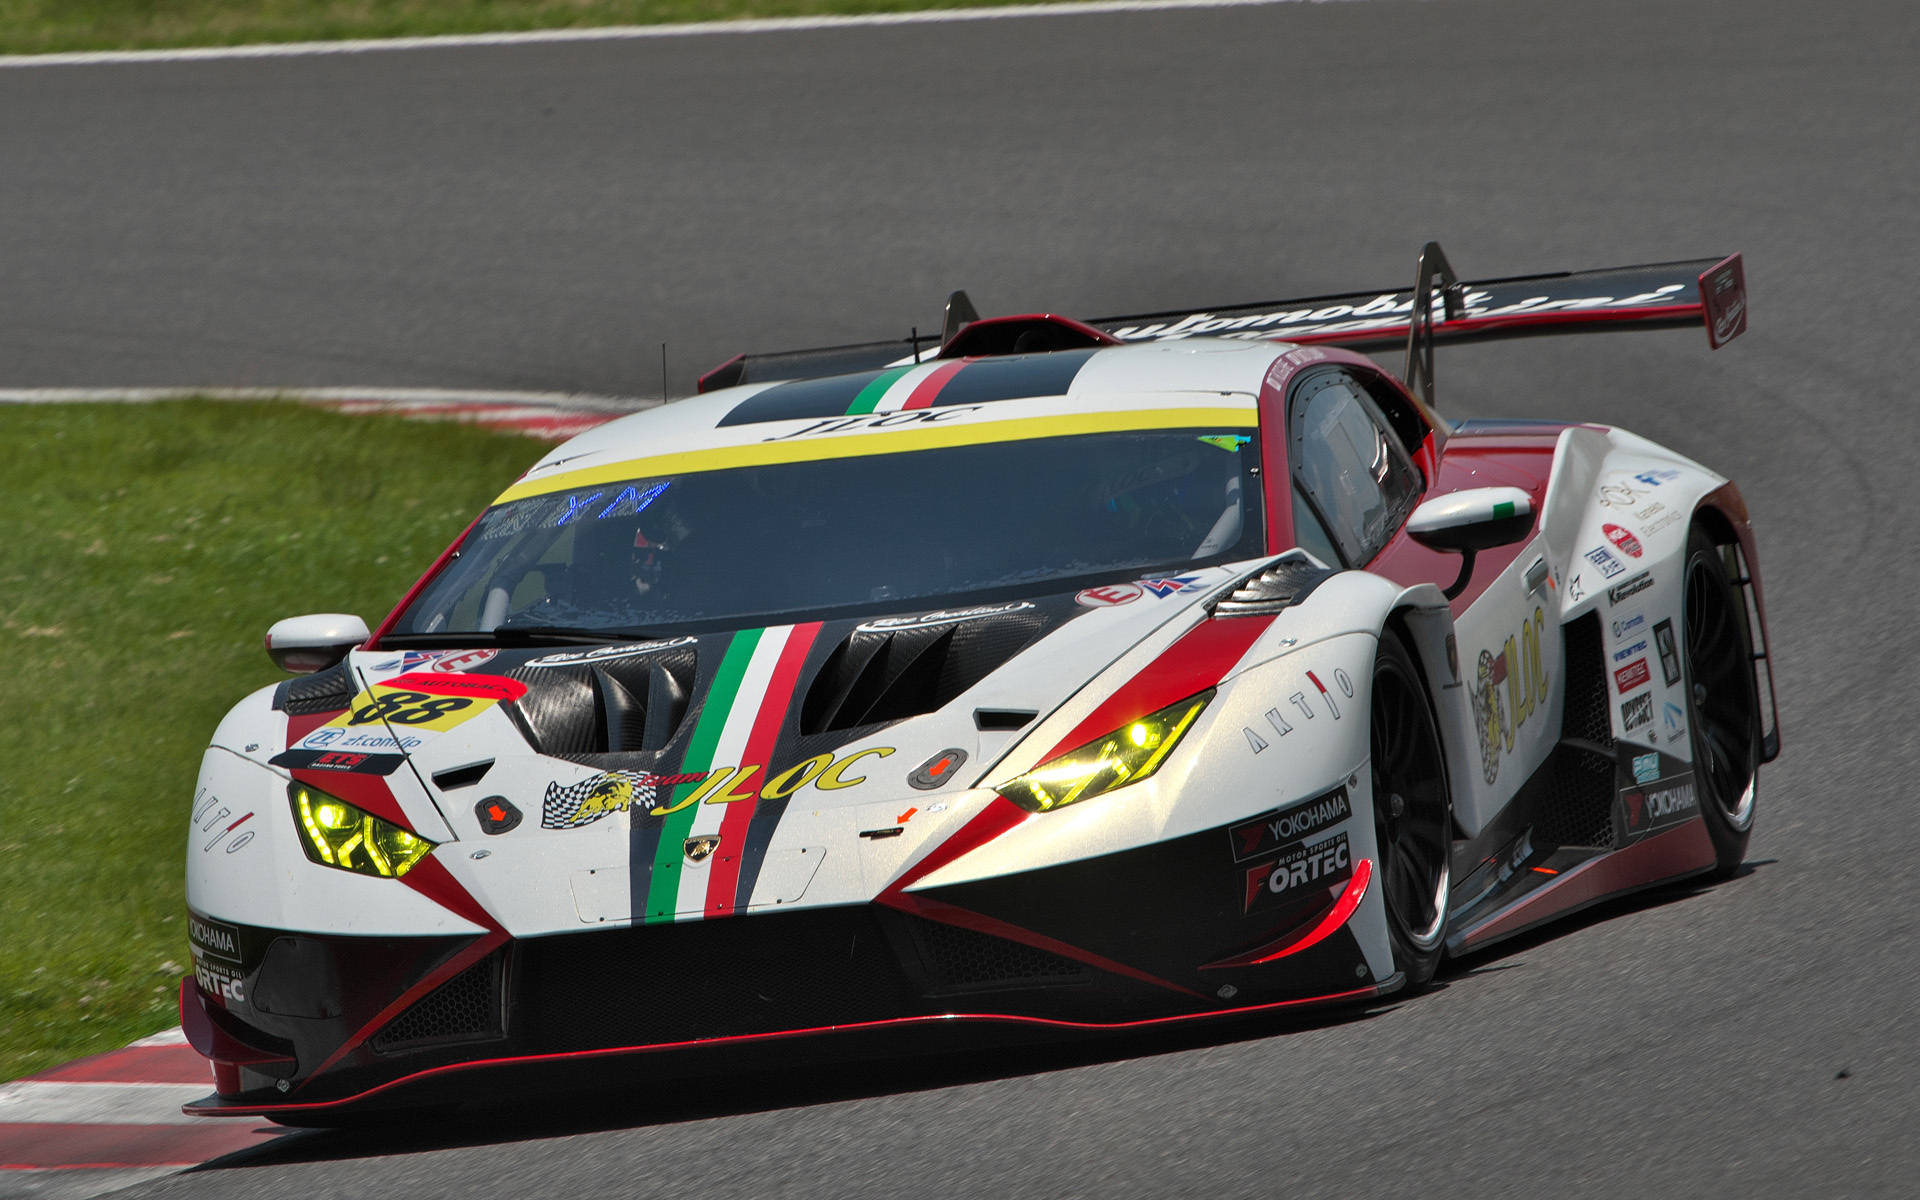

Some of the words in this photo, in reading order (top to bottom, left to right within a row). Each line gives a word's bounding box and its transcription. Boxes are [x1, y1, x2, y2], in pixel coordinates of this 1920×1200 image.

[762, 406, 984, 442] JLOC
[347, 692, 473, 725] 88
[306, 730, 339, 747] ZF
[318, 751, 368, 766] ETS
[637, 770, 710, 788] Team
[650, 747, 897, 816] JLOC
[1268, 794, 1347, 841] YOKOHAMA
[1278, 850, 1307, 866] MOTOR
[1309, 838, 1335, 854] SPORTS
[1336, 832, 1347, 843] OIL
[196, 964, 245, 1002] ORTEC
